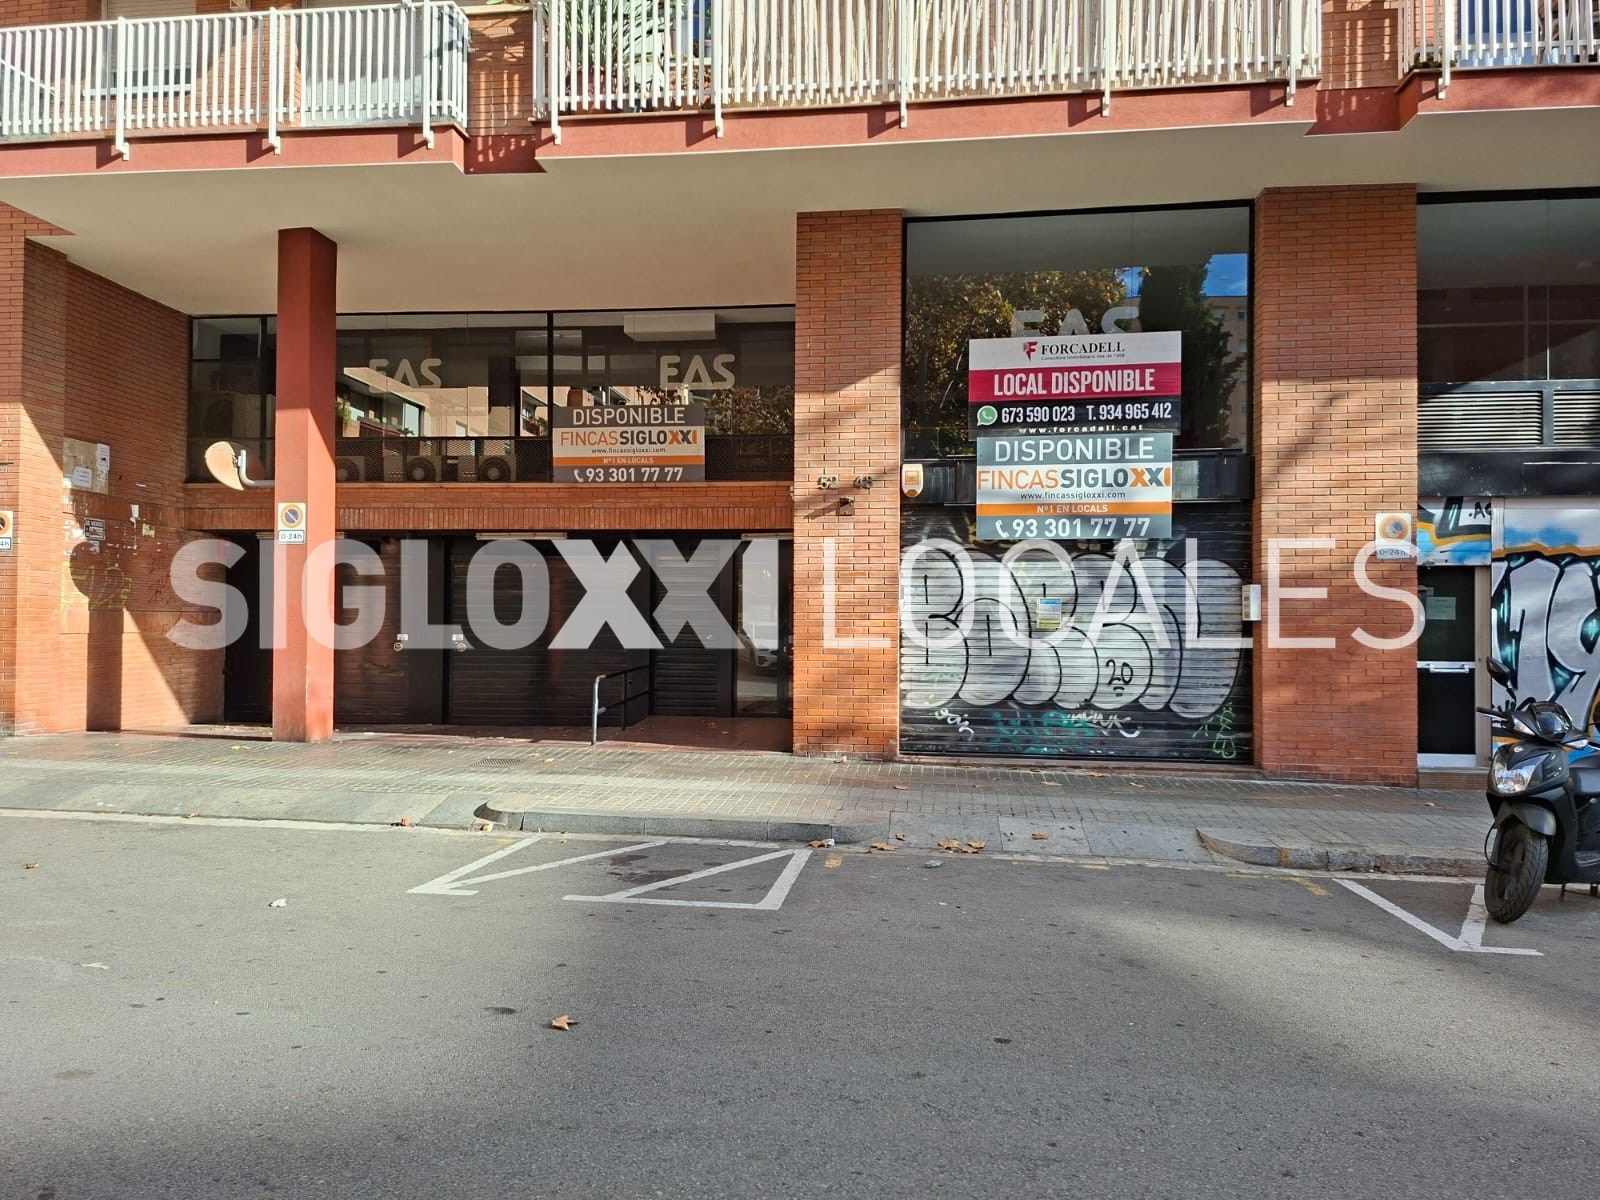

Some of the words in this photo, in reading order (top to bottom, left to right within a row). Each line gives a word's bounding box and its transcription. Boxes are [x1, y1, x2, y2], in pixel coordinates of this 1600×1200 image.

[1041, 341, 1125, 355] FORCADELL
[660, 354, 735, 390] EAS
[993, 373, 1047, 396] LOCAL
[1051, 368, 1156, 395] DISPONIBLE
[573, 407, 685, 425] DISPONIBLE
[1001, 407, 1024, 423] 673
[1026, 406, 1050, 422] 590
[1052, 405, 1075, 422] 023
[1099, 404, 1122, 420] 934
[1125, 403, 1149, 419] 965
[1151, 402, 1172, 418] 412
[995, 437, 1154, 462] DISPONIBLE
[628, 456, 654, 464] LOCALS
[586, 468, 605, 482] 93
[609, 467, 635, 481] 301
[641, 467, 660, 481] 77
[664, 467, 683, 481] 77
[1020, 490, 1126, 500] www.fincassigloxxi.com
[1056, 505, 1070, 513] EN
[1072, 504, 1108, 513] LOCALS
[1012, 518, 1038, 538] 93
[1044, 518, 1081, 537] 301
[1090, 517, 1117, 537] 77
[1123, 517, 1151, 537] 77
[1105, 659, 1134, 685] 20
